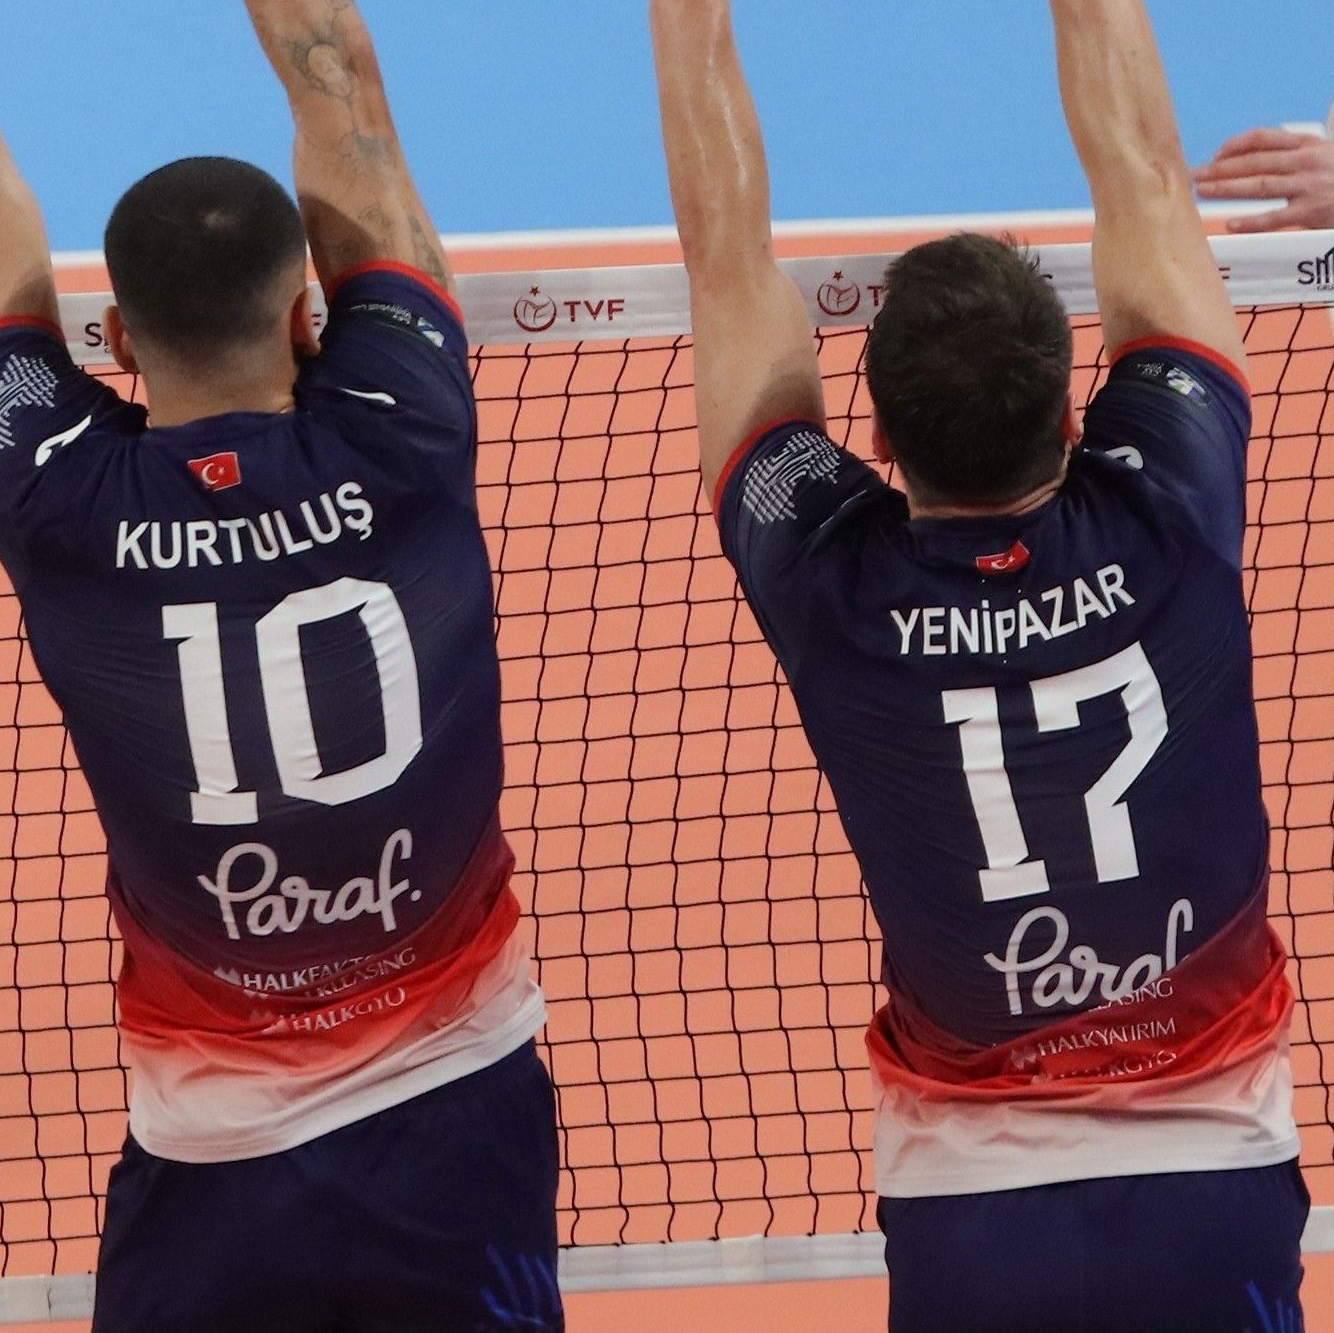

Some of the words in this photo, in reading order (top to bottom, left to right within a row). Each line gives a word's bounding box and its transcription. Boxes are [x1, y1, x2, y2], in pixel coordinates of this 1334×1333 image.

[563, 299, 625, 322] TVF
[116, 480, 375, 569] KURTULUŞ
[889, 563, 1136, 654] YENİPAZAR
[162, 576, 424, 826] 10
[941, 640, 1168, 903] 17
